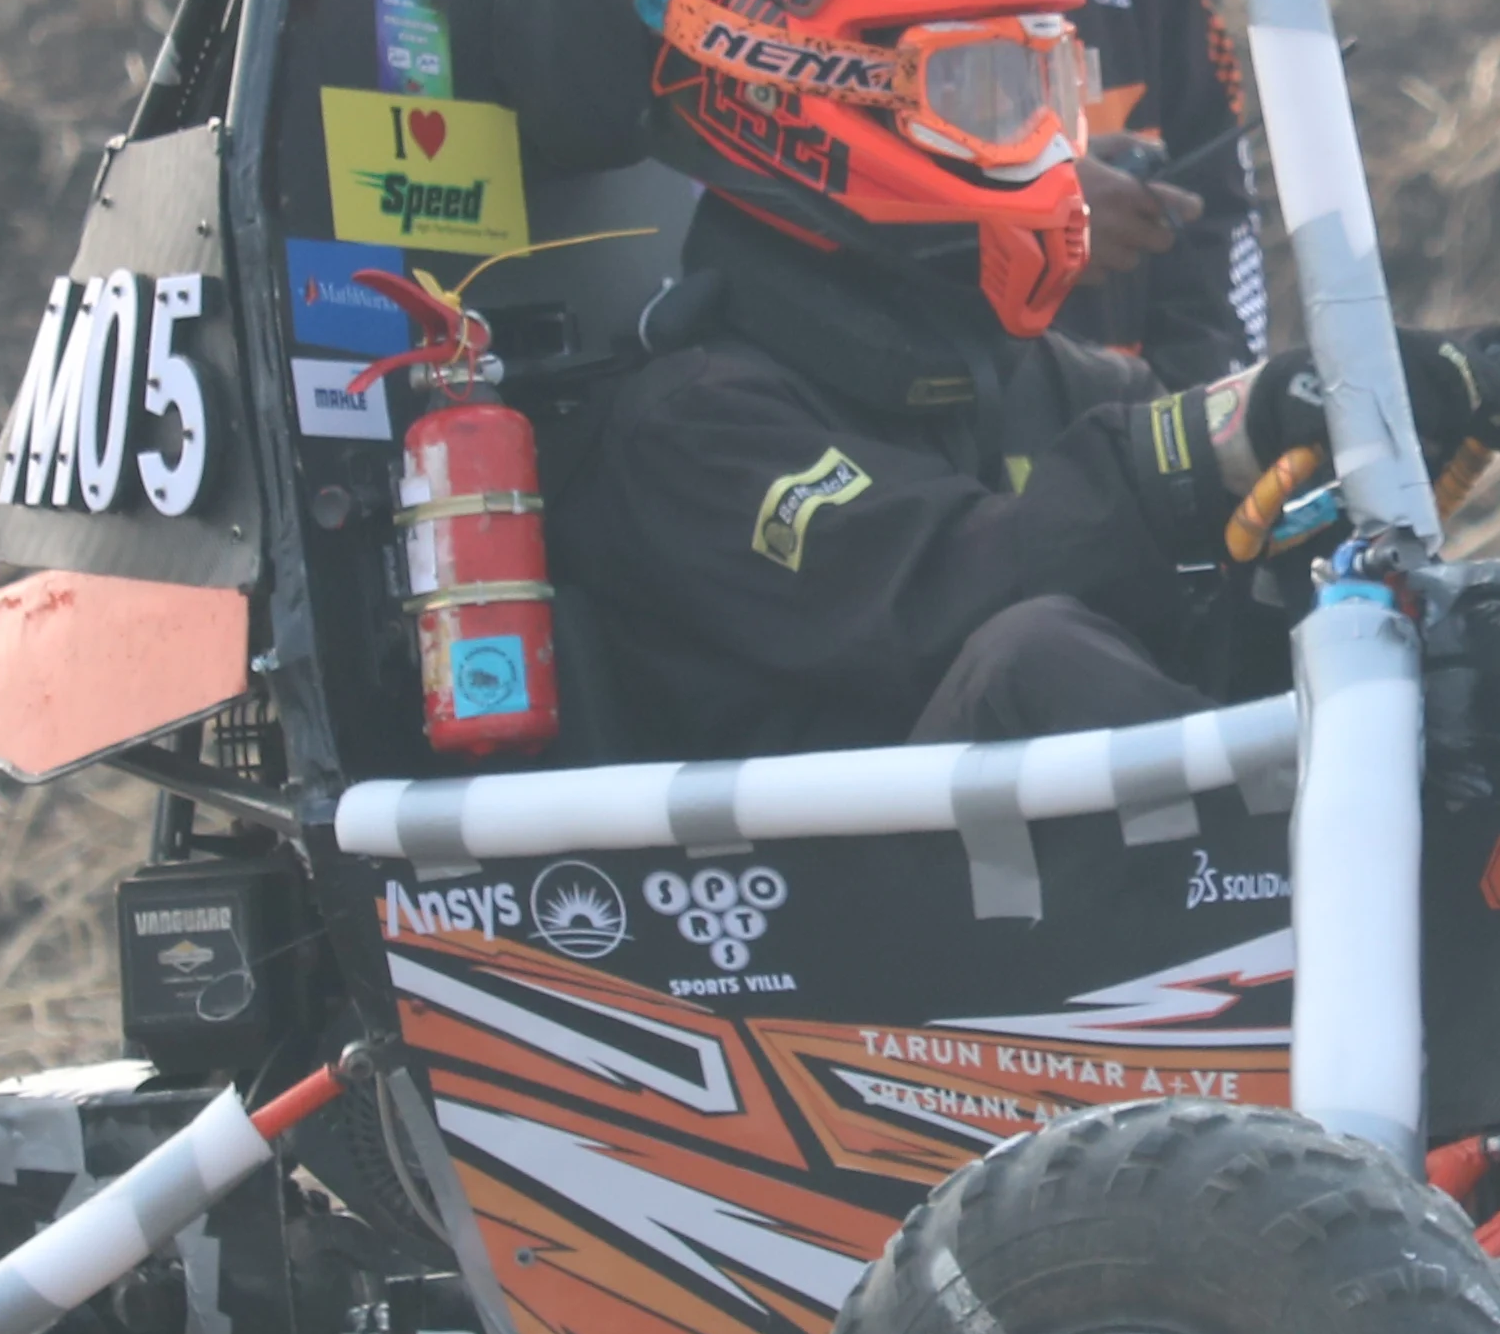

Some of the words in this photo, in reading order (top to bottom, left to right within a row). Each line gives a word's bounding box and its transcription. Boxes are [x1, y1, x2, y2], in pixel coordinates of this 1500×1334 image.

[390, 106, 407, 160] I
[380, 171, 487, 236] Speed
[133, 906, 232, 937] VANGUARD
[386, 879, 522, 941] Ansys
[669, 976, 741, 997] SPORTS
[744, 973, 798, 993] VILLA
[859, 1028, 983, 1068] TARUN
[996, 1044, 1126, 1089] KUMAR
